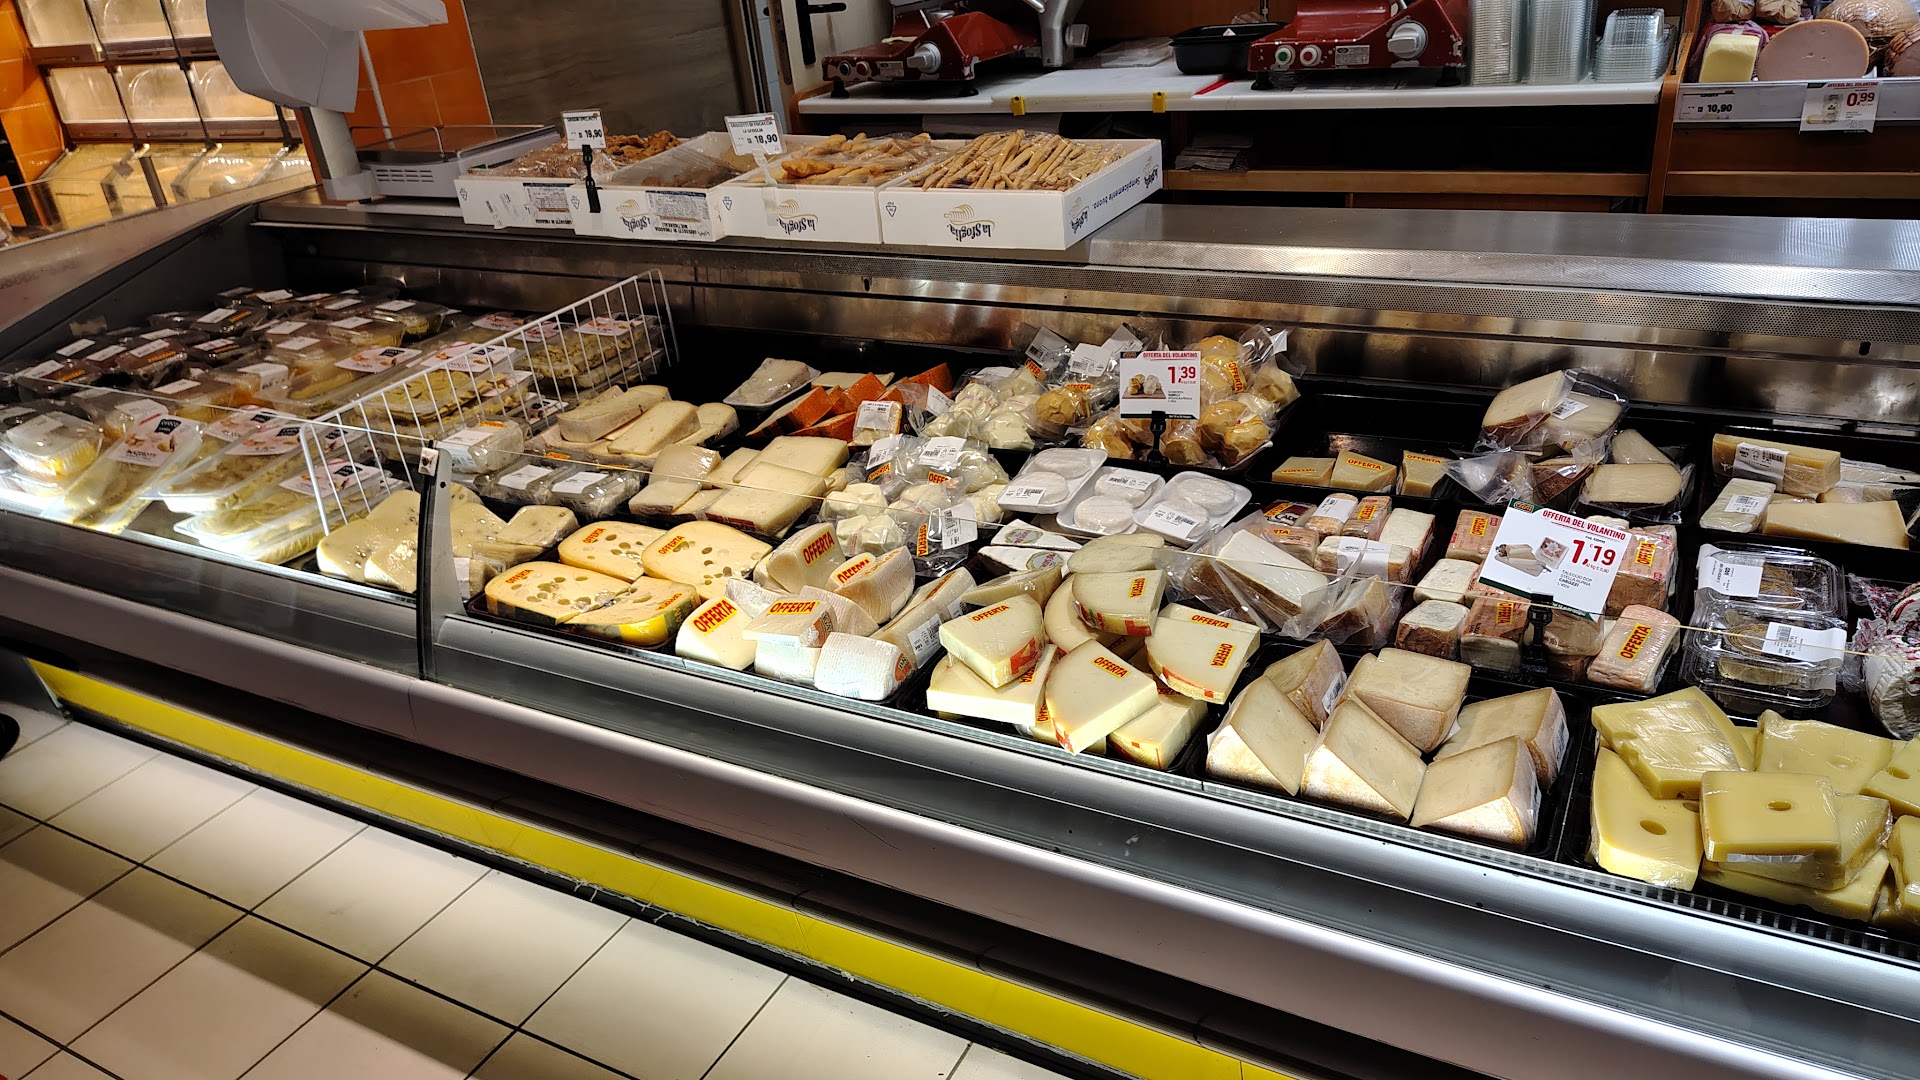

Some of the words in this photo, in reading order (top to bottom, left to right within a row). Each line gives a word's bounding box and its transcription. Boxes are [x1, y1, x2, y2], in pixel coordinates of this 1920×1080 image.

[1847, 92, 1875, 107] 0,99
[1708, 104, 1732, 114] 10,90
[585, 129, 602, 139] 19,90
[754, 133, 778, 144] 18,90
[1167, 366, 1196, 384] 1,39
[1348, 459, 1382, 470] OFFERTA
[1406, 454, 1441, 463] OFFERTA
[1543, 510, 1571, 524] OFFERTA
[1572, 518, 1585, 528] DEL
[1587, 522, 1626, 541] VOLANTINO
[583, 528, 606, 544] OFFERTA
[918, 524, 927, 557] OFFERTA
[658, 535, 685, 554] OFFERTA
[803, 531, 835, 565] OFFERTA
[506, 569, 533, 584] OFFERTA
[770, 601, 816, 613] OFFERTA
[972, 605, 1009, 621] OFFERTA
[693, 600, 737, 632] OFFERTA
[1191, 614, 1230, 628] OFFERTA
[1620, 626, 1651, 659] OFFERTA
[1211, 643, 1233, 666] OFFERTA
[1093, 656, 1128, 678] OFFERTA
